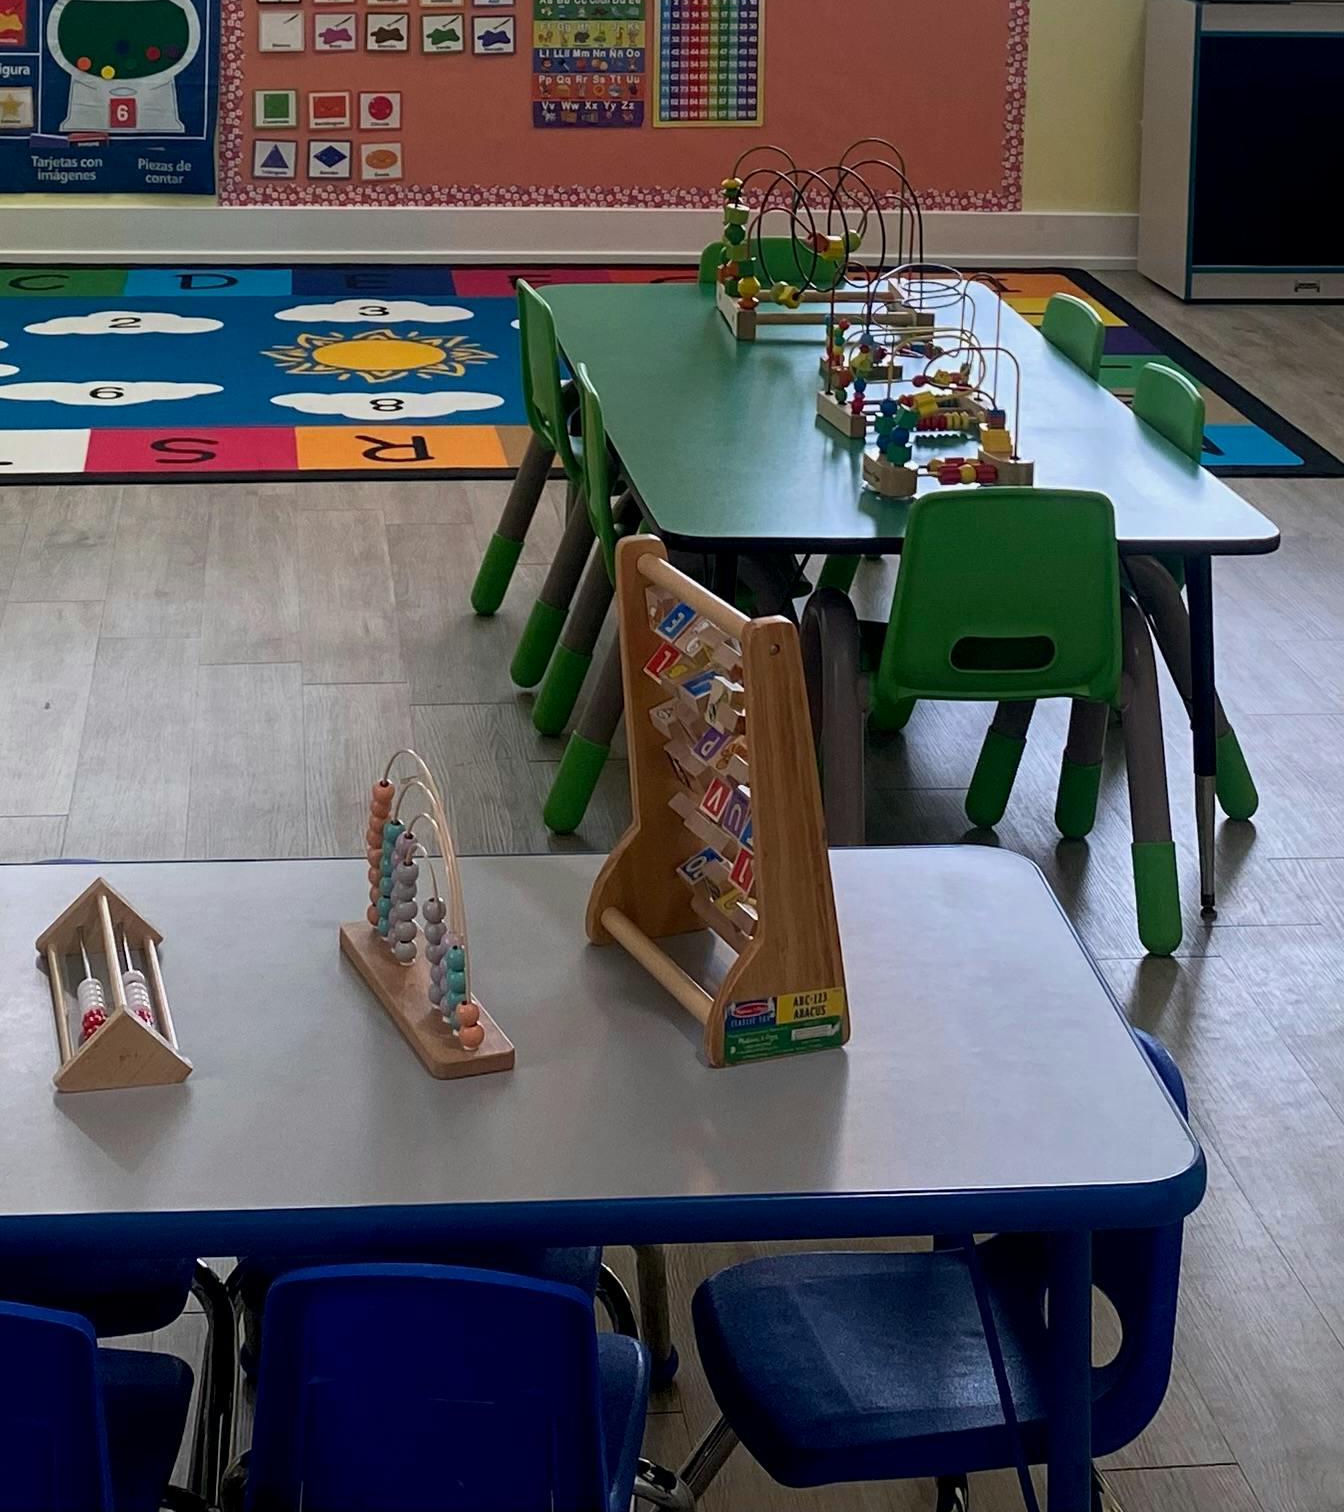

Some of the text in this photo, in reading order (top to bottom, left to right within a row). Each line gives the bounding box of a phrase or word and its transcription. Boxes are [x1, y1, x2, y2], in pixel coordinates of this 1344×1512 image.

[572, 50, 590, 58] Mm
[592, 50, 606, 58] Nn
[626, 50, 641, 58] Oo
[539, 76, 640, 85] Pp Qq Rr Ss Tt Uu
[116, 104, 129, 122] 6
[542, 102, 635, 111] Vv Ww Xx Yy Zz
[32, 156, 103, 169] Tarjetas con
[138, 158, 192, 172] Piezas de
[38, 170, 96, 183] imágenes
[146, 172, 184, 185] contar
[8, 274, 71, 291] C
[176, 274, 239, 290] D
[344, 274, 392, 289] E
[359, 306, 391, 317] 3
[108, 316, 142, 329] 2
[370, 398, 405, 411] 8
[150, 438, 219, 464] S
[355, 435, 435, 462] R
[794, 1006, 826, 1020] ABACUS
